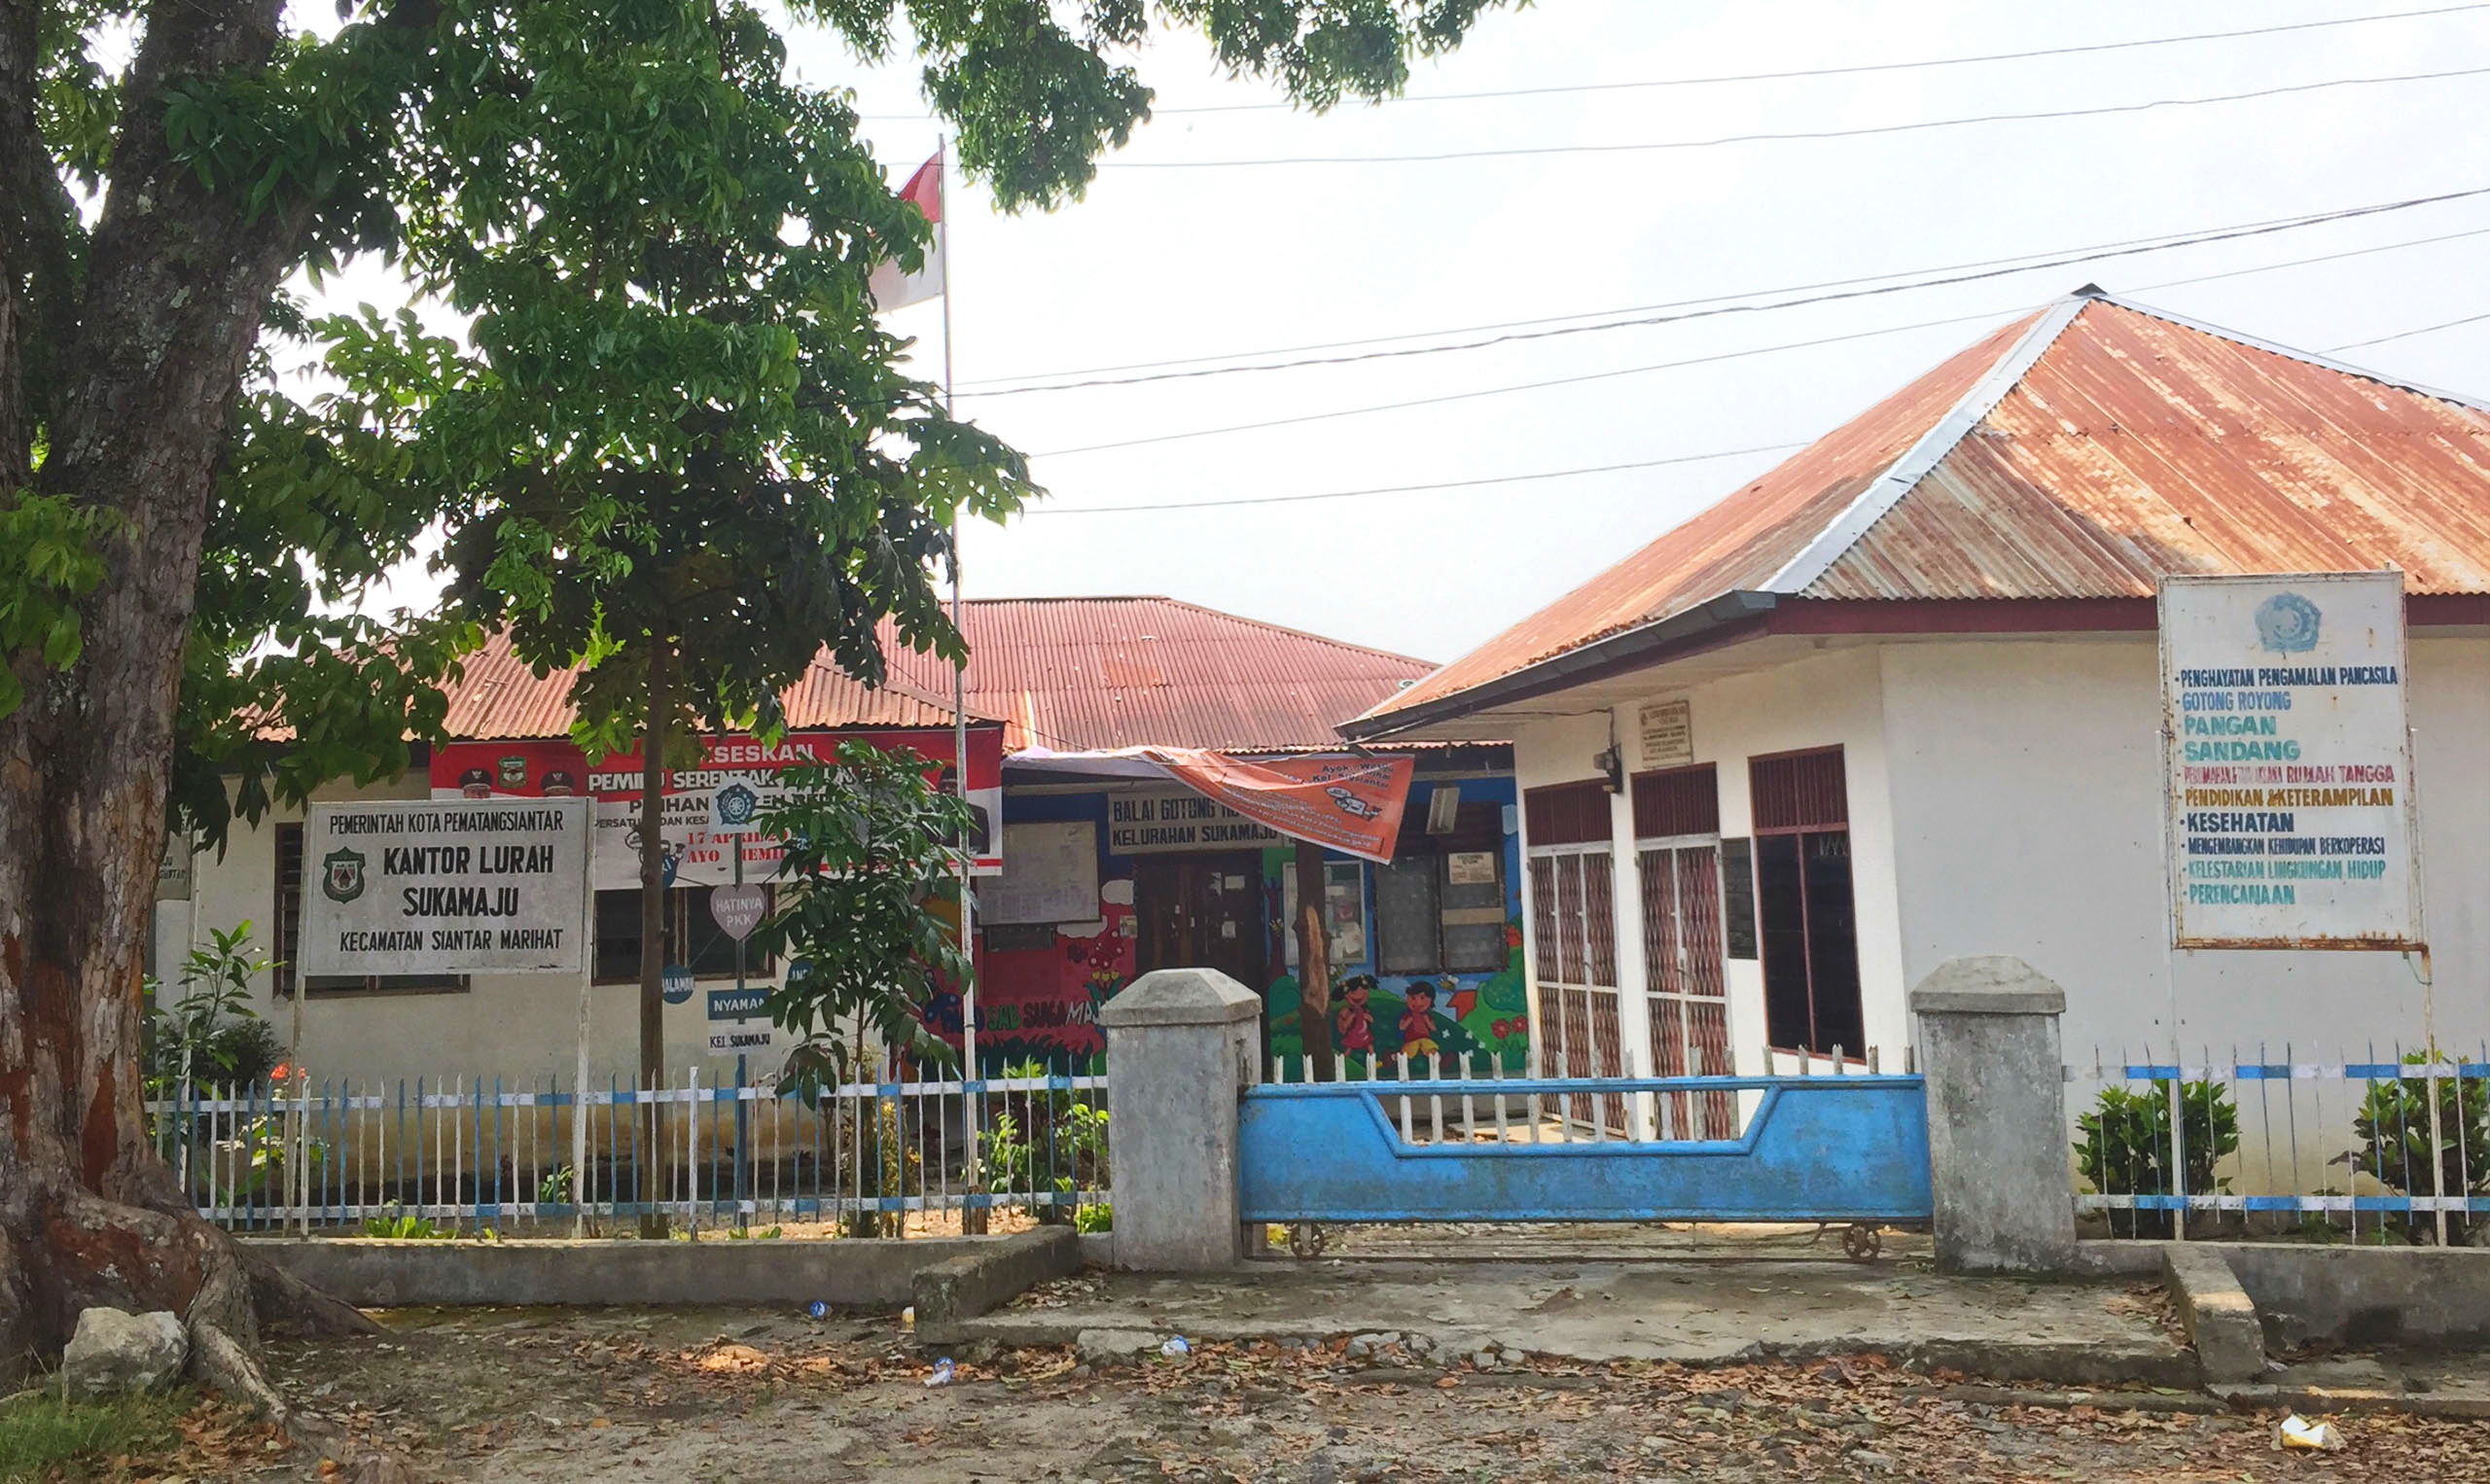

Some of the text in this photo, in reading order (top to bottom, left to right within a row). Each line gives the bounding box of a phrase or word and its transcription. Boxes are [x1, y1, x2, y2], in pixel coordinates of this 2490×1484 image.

[2181, 666, 2398, 688] PENGHAYATAN PENGAMALAN PANCASILA
[2182, 691, 2292, 711] GOTONG ROYONG
[2185, 715, 2277, 736] PANGAN
[2185, 739, 2301, 762] SANDANG
[2338, 764, 2396, 784] TANGGA
[2186, 788, 2263, 806] PENDIDIKAN
[1113, 799, 1156, 822] BALAI
[1160, 797, 1216, 820] GOTONG
[330, 810, 563, 834] PEMERINTAH KOTA PEMATANGSIANTAR
[2187, 813, 2294, 832] KESEHATAN
[1113, 827, 1196, 847] KELURAHAN
[2320, 837, 2385, 855] BERKOPERASI
[383, 845, 553, 875] KANTOR LURAH
[687, 850, 720, 864] AYO
[2188, 860, 2386, 879] KELESTARIAN LINGKUNGAN HIDUP
[403, 887, 518, 917] SUKAMAJU
[716, 898, 764, 913] HATINYA
[727, 913, 753, 927] PKK
[339, 929, 563, 952] KECAMATAN SIANTAR MARIHAT
